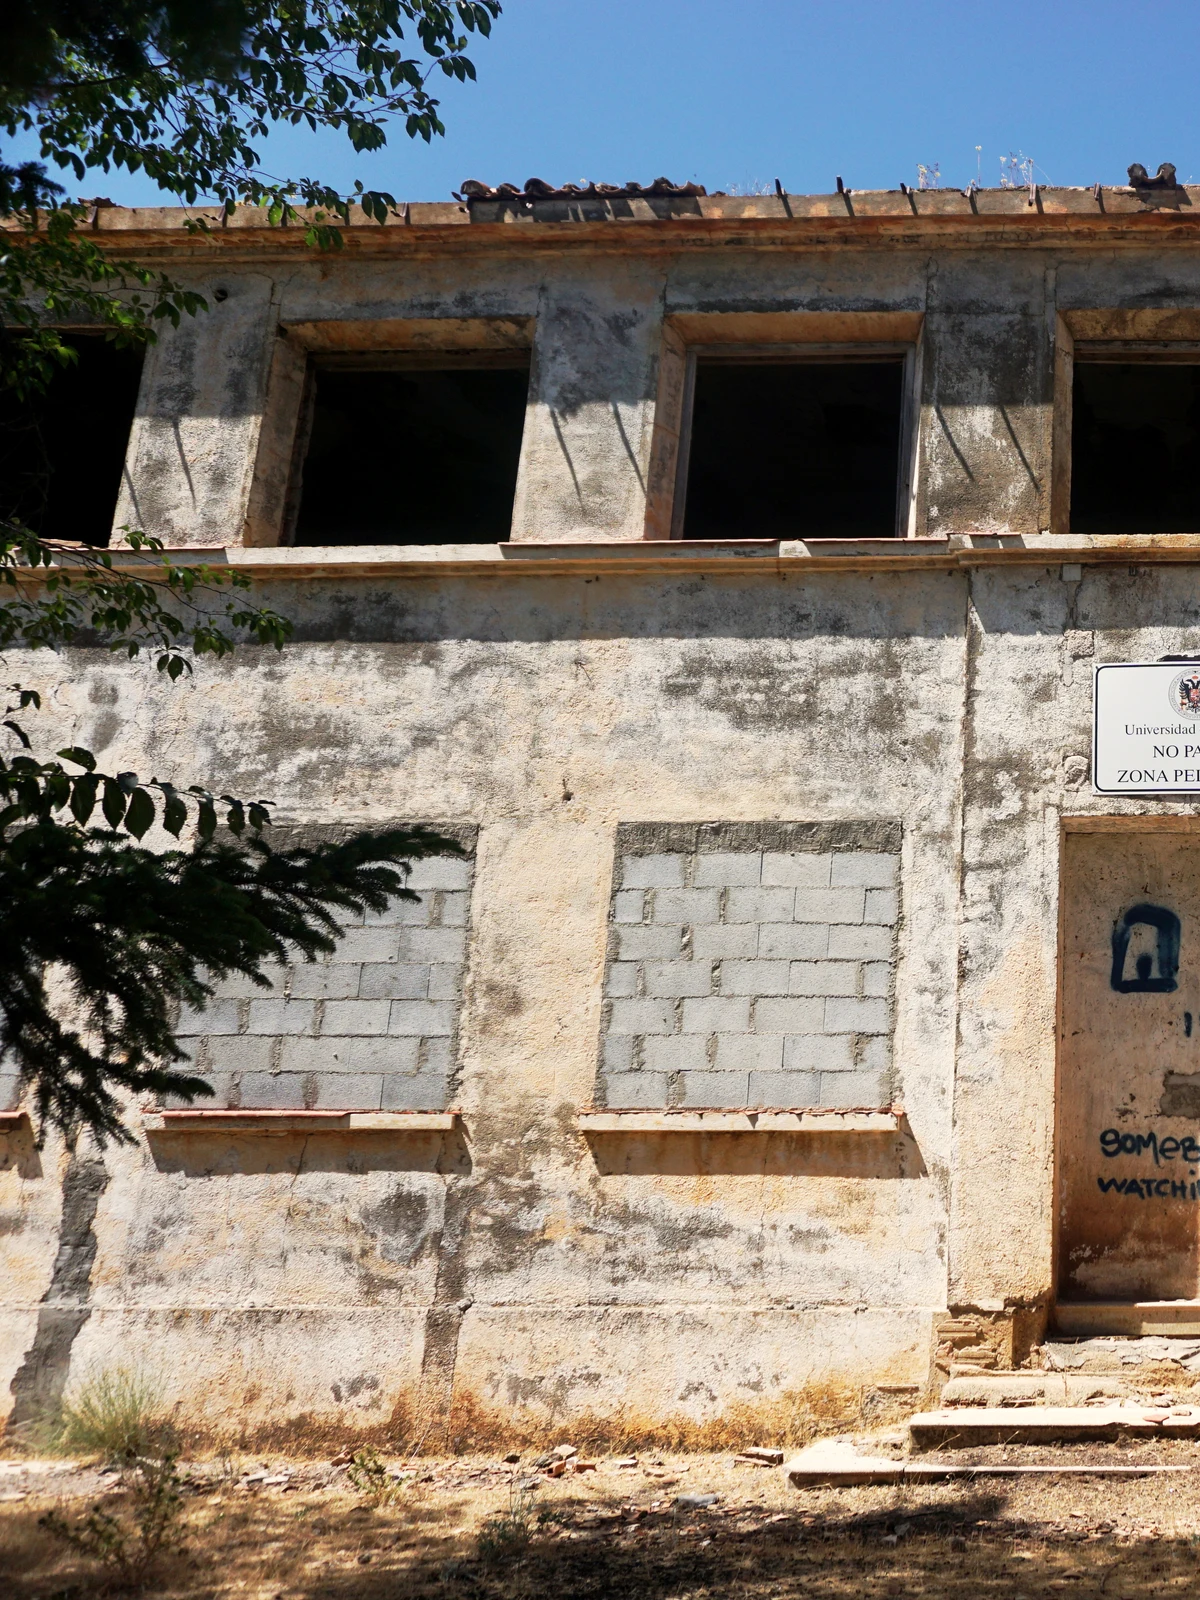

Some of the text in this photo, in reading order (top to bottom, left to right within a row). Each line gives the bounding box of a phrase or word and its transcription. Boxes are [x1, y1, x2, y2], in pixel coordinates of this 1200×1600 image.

[1124, 723, 1196, 735] Universidad
[1152, 745, 1179, 758] NO
[1117, 769, 1169, 783] ZONA
